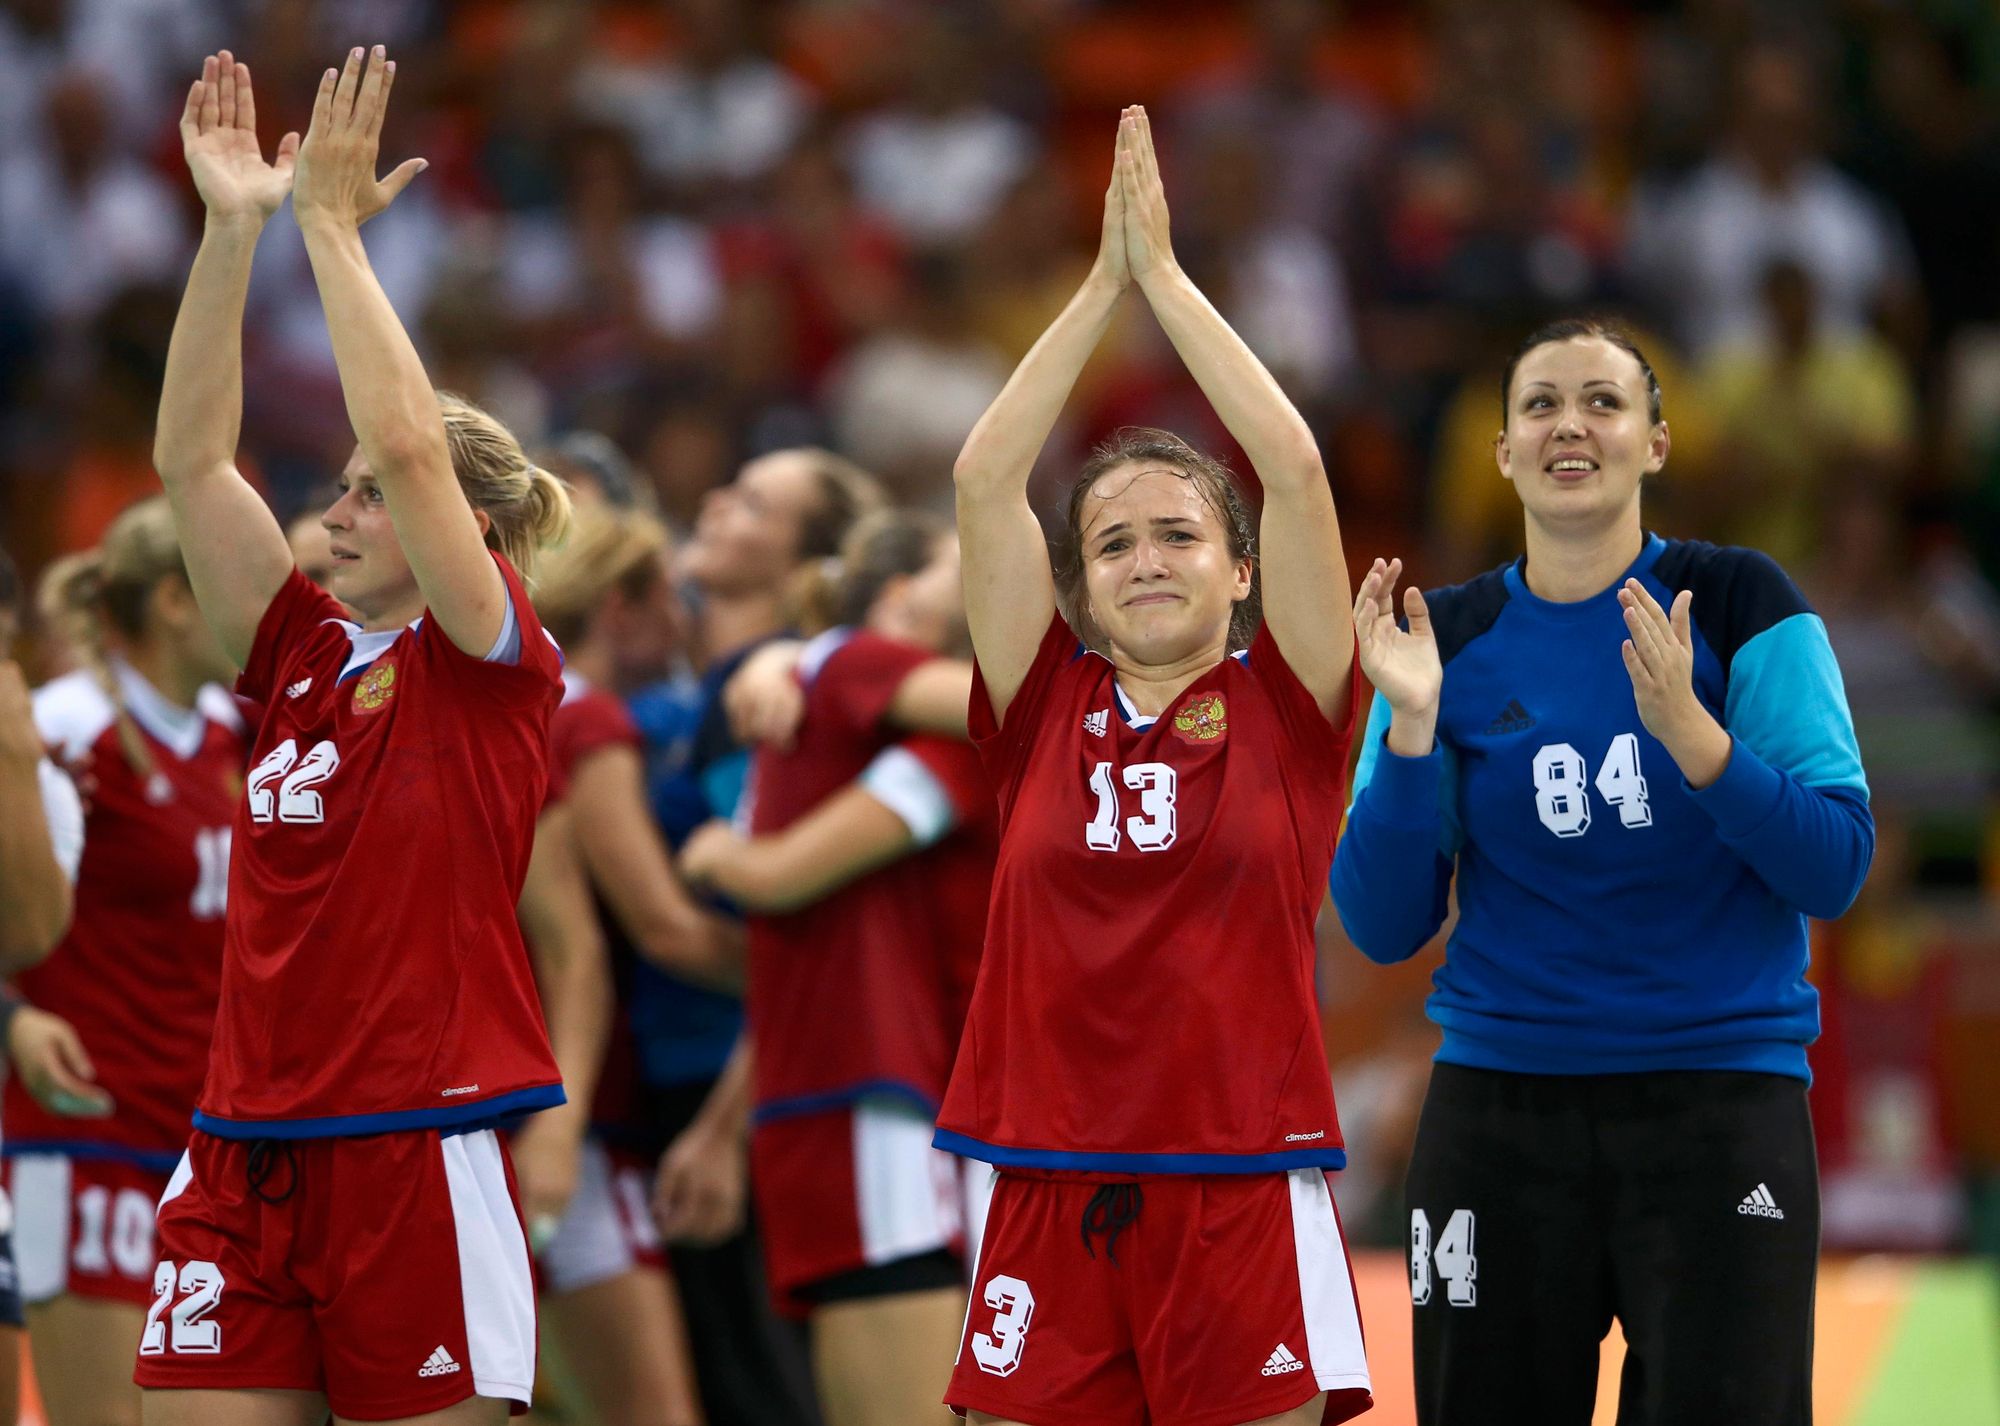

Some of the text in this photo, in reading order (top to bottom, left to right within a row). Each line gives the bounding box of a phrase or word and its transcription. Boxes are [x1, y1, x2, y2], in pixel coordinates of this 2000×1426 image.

[247, 739, 341, 823] 22
[1532, 732, 1653, 838] 84
[1086, 761, 1177, 852] 13
[441, 1083, 480, 1097] climacool
[1285, 1129, 1324, 1142] climacool
[76, 1185, 156, 1278] 10
[1737, 1203, 1785, 1220] adidas
[139, 1260, 226, 1356] 22
[418, 1362, 461, 1377] adidas
[1261, 1360, 1304, 1377] adidas
